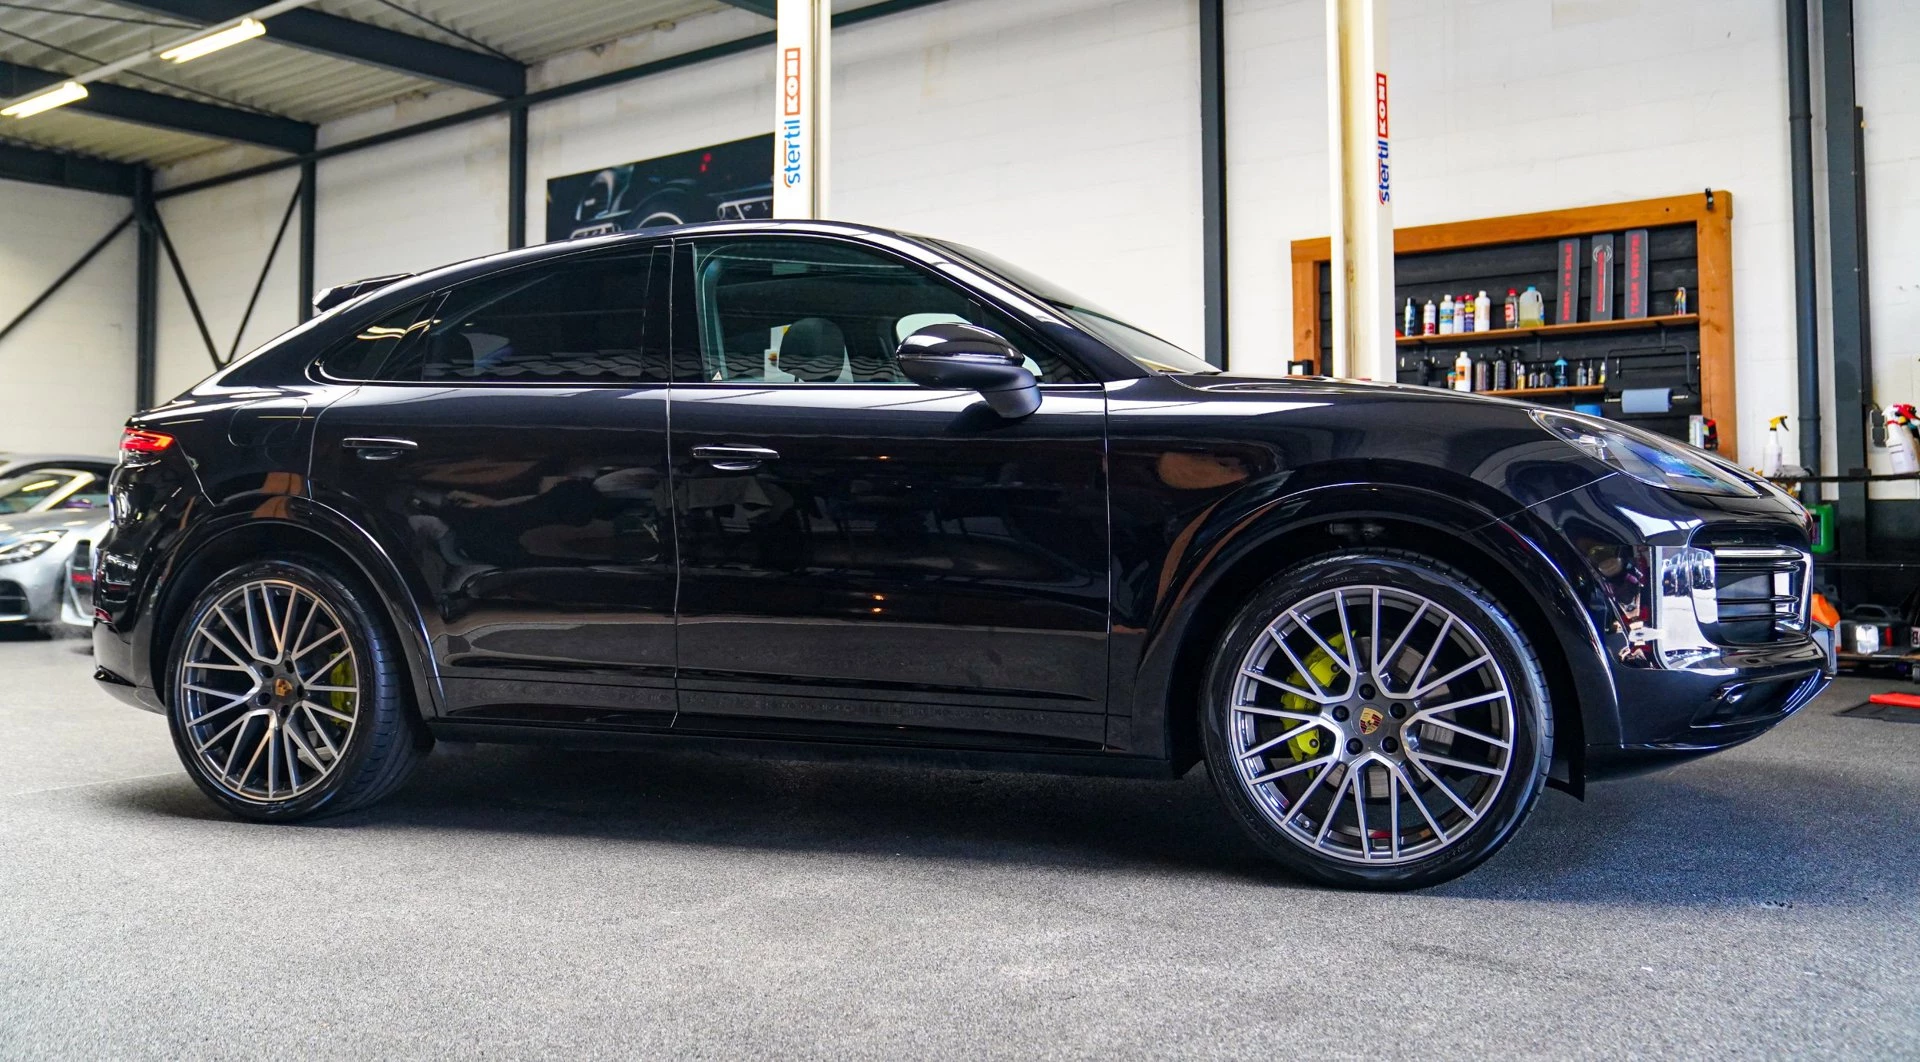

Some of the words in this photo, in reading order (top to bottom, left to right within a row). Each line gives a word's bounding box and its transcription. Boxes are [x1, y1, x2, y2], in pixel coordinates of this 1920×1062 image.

[785, 49, 800, 115] KONI
[1377, 73, 1388, 138] KONI
[784, 119, 801, 186] stertil
[1378, 140, 1390, 204] stertil
